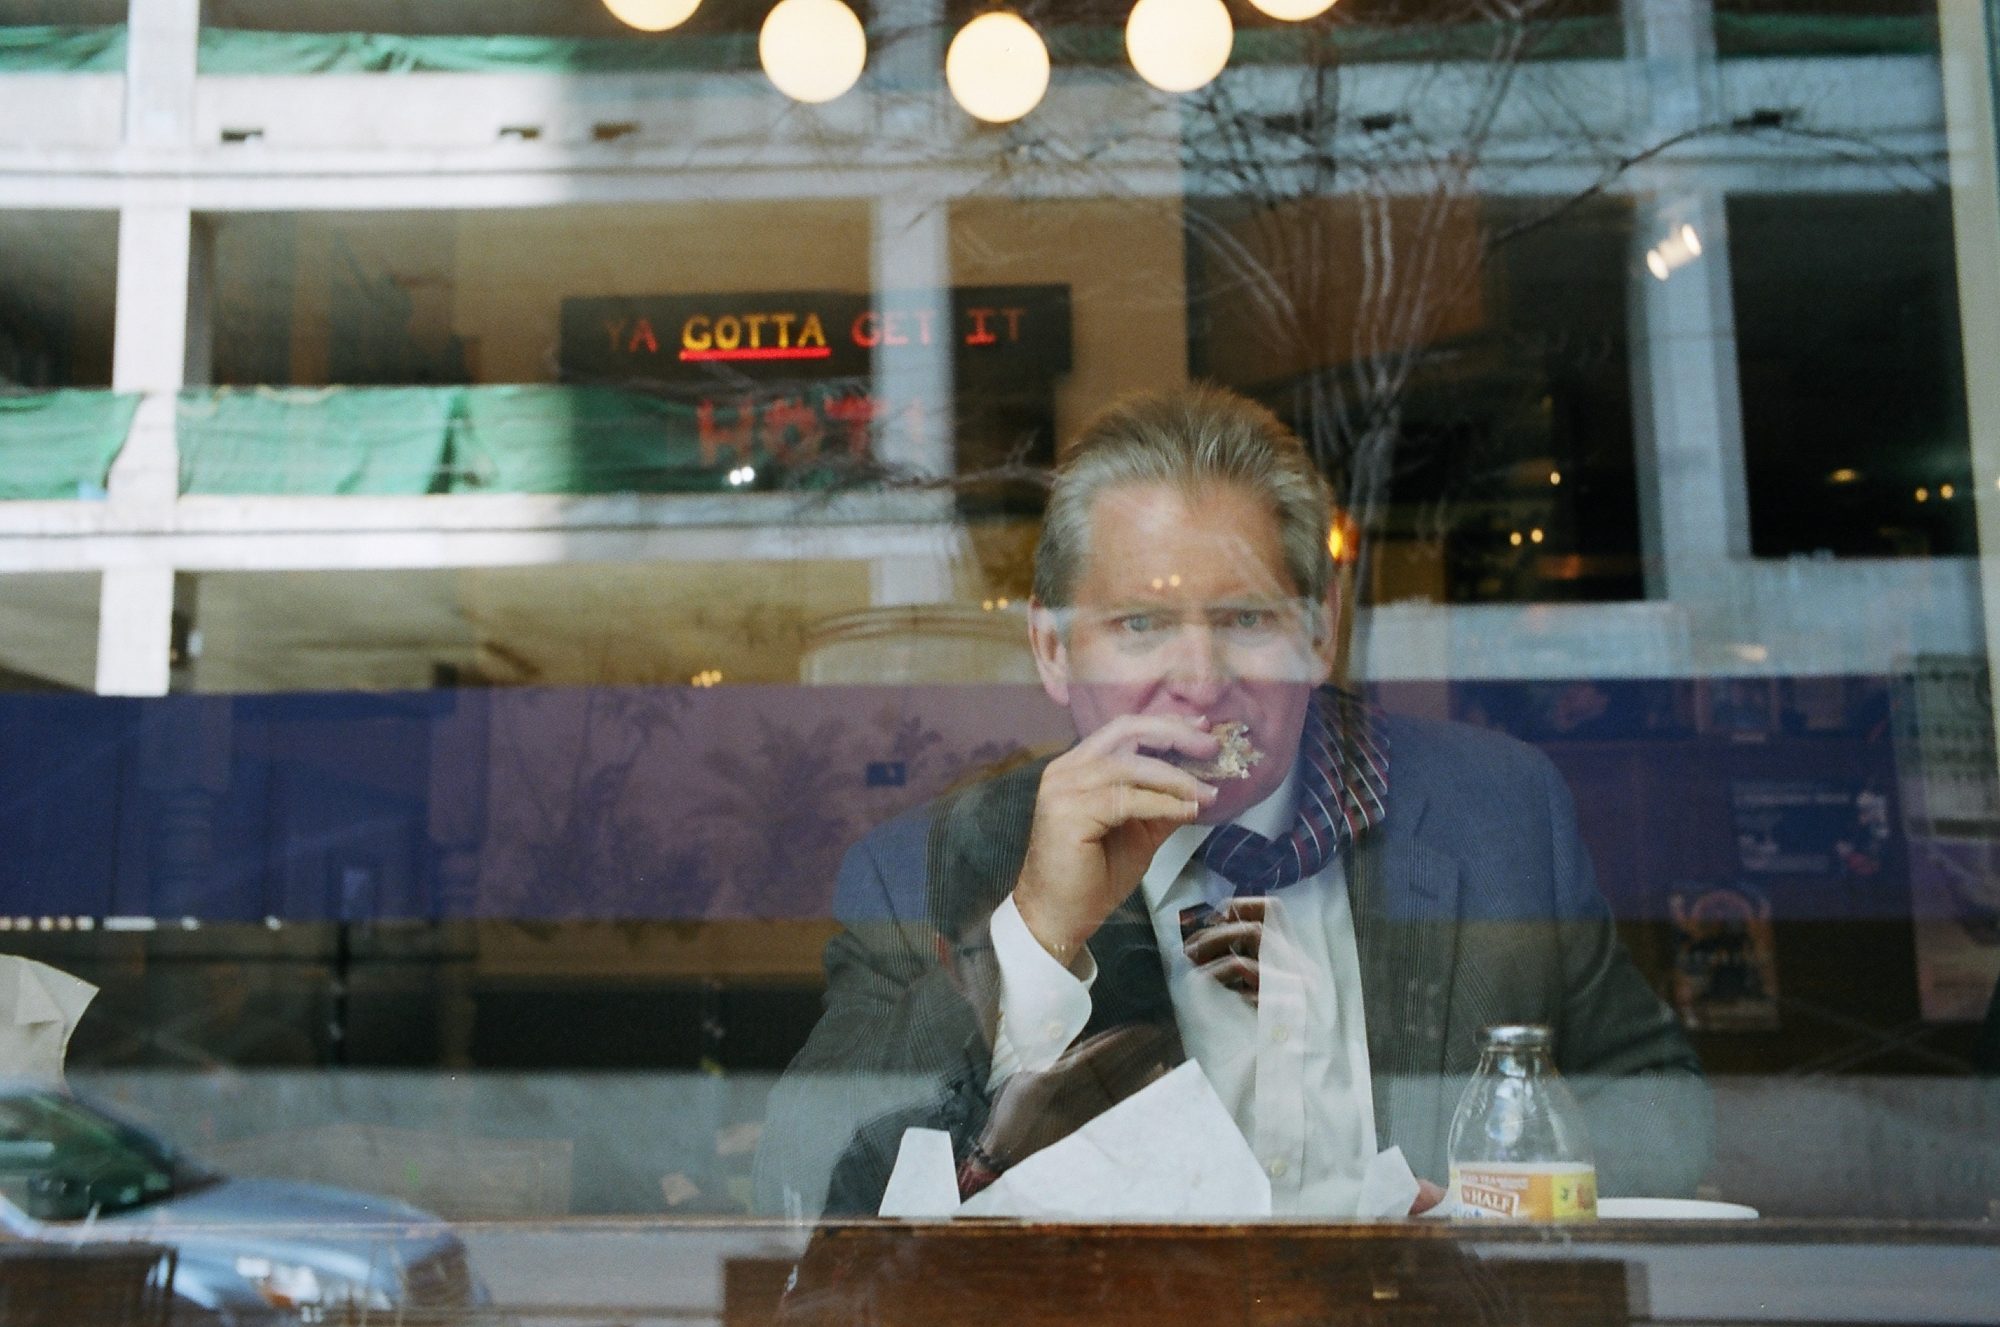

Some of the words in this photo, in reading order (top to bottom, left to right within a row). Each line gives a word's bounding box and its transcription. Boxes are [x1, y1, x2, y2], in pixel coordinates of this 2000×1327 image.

[606, 320, 658, 353] YA
[683, 312, 827, 351] GOTTA
[851, 312, 936, 348] GET
[966, 307, 1026, 345] IT
